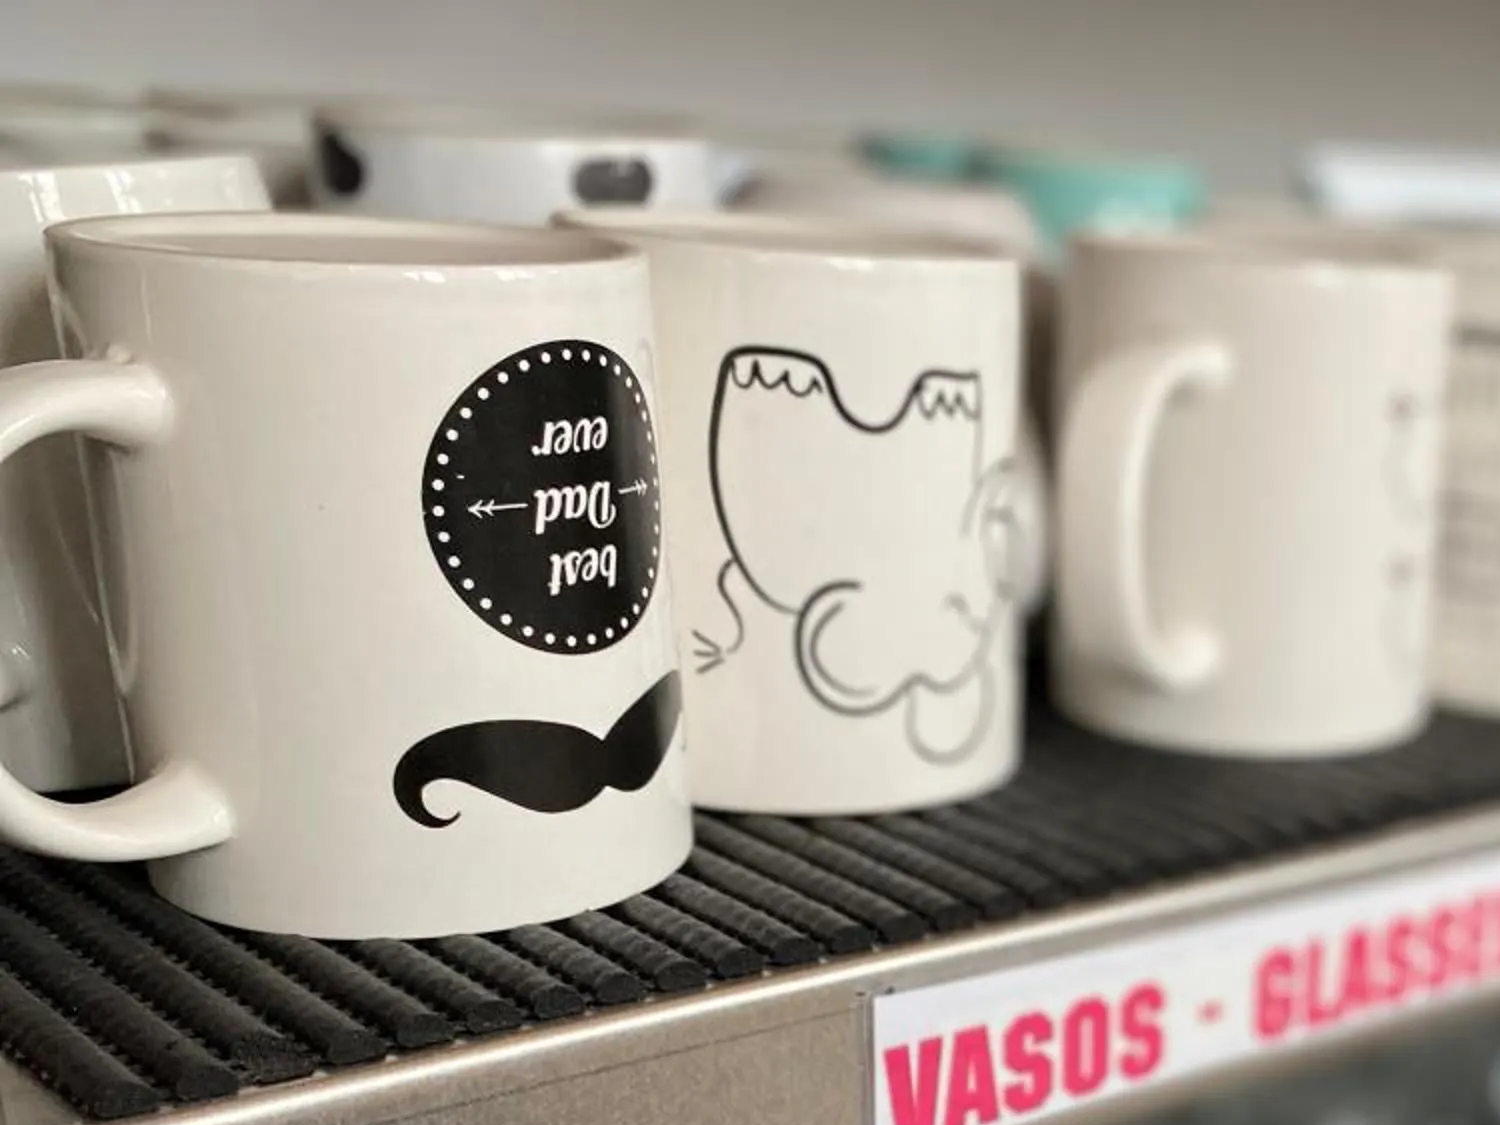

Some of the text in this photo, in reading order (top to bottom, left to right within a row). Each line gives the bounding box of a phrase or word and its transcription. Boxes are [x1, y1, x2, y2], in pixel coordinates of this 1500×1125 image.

[531, 415, 608, 456] ever
[533, 480, 616, 535] Dad
[548, 543, 617, 596] best
